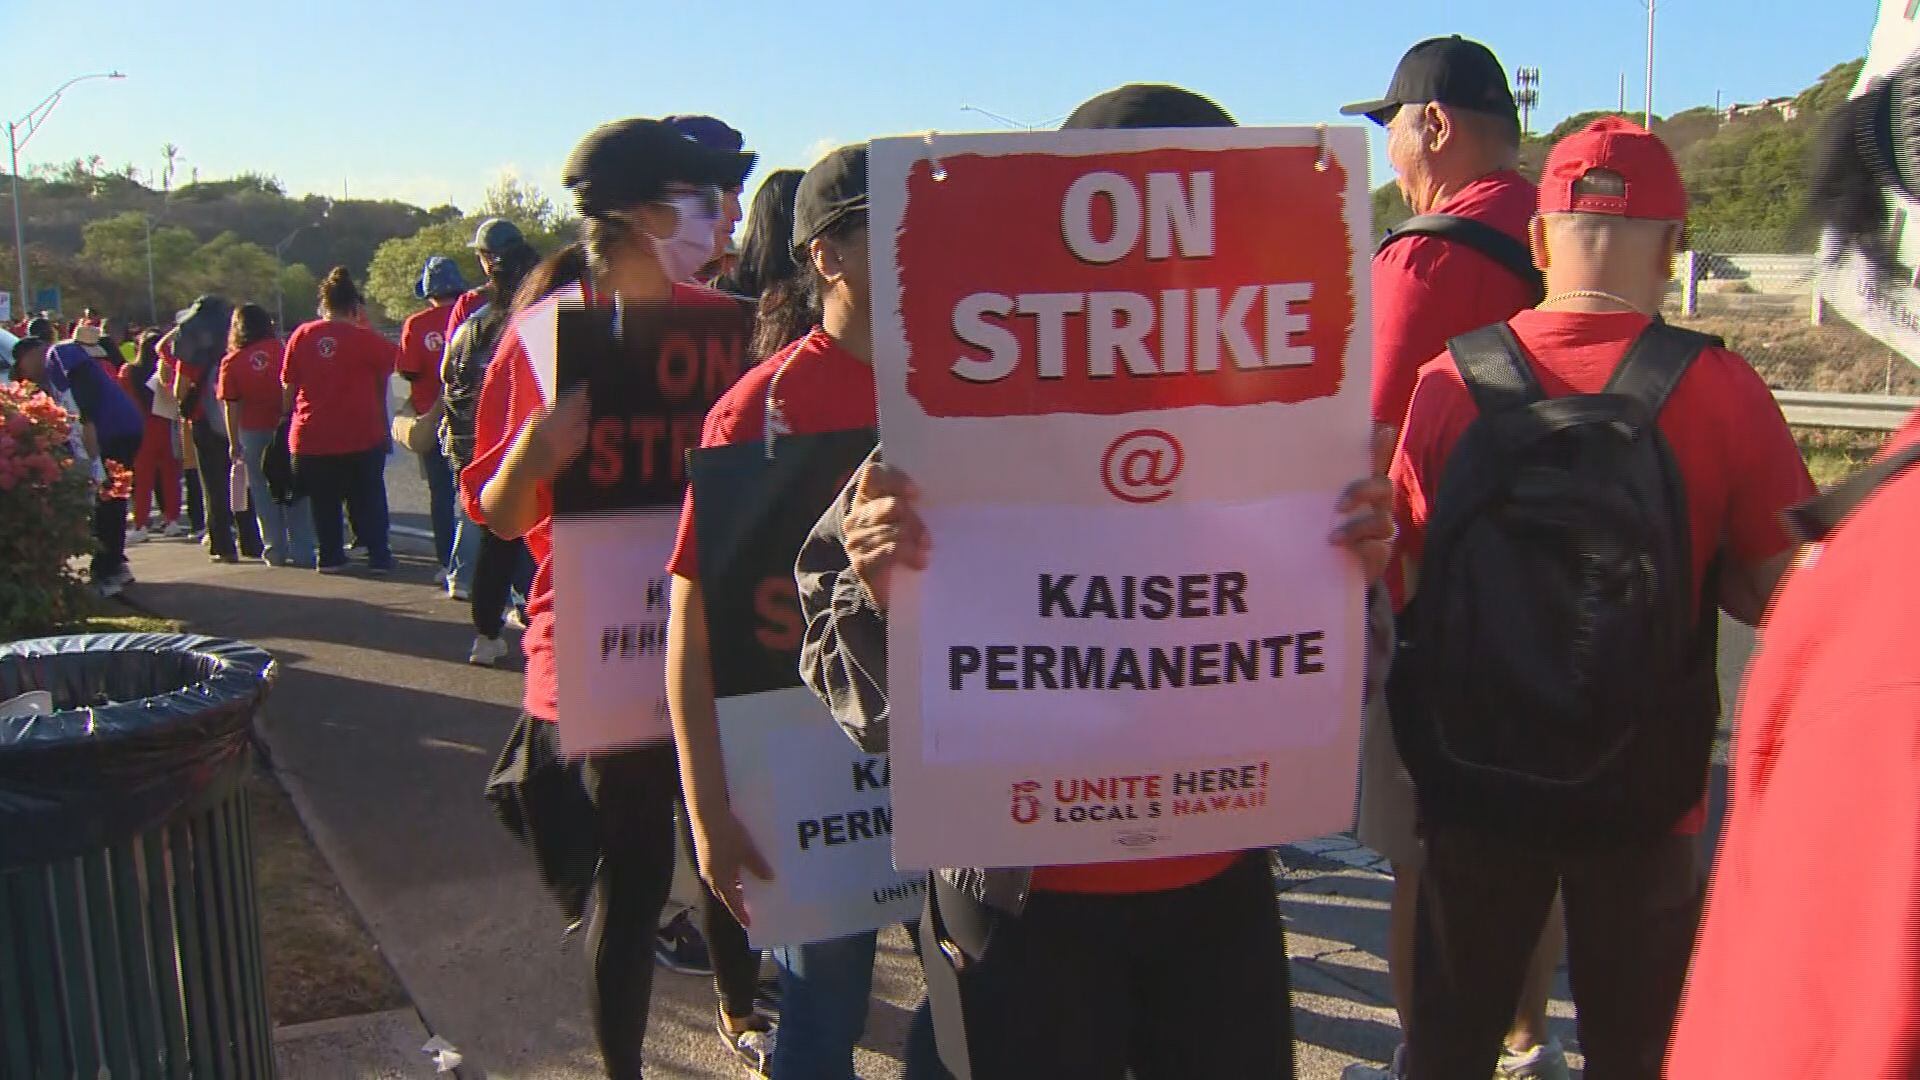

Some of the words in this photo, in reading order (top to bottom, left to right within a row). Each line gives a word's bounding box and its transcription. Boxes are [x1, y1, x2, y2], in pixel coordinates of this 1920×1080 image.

[1061, 171, 1216, 264] ON
[951, 282, 1315, 385] STRIKE
[657, 332, 742, 401] ON
[1100, 429, 1185, 503] @
[1038, 571, 1249, 622] KAISER
[949, 631, 1325, 690] PERMANENTE
[1054, 774, 1163, 804] UNITE
[1172, 761, 1269, 796] HERE!
[1054, 804, 1139, 824] LOCAL
[1172, 790, 1267, 817] HAWAII
